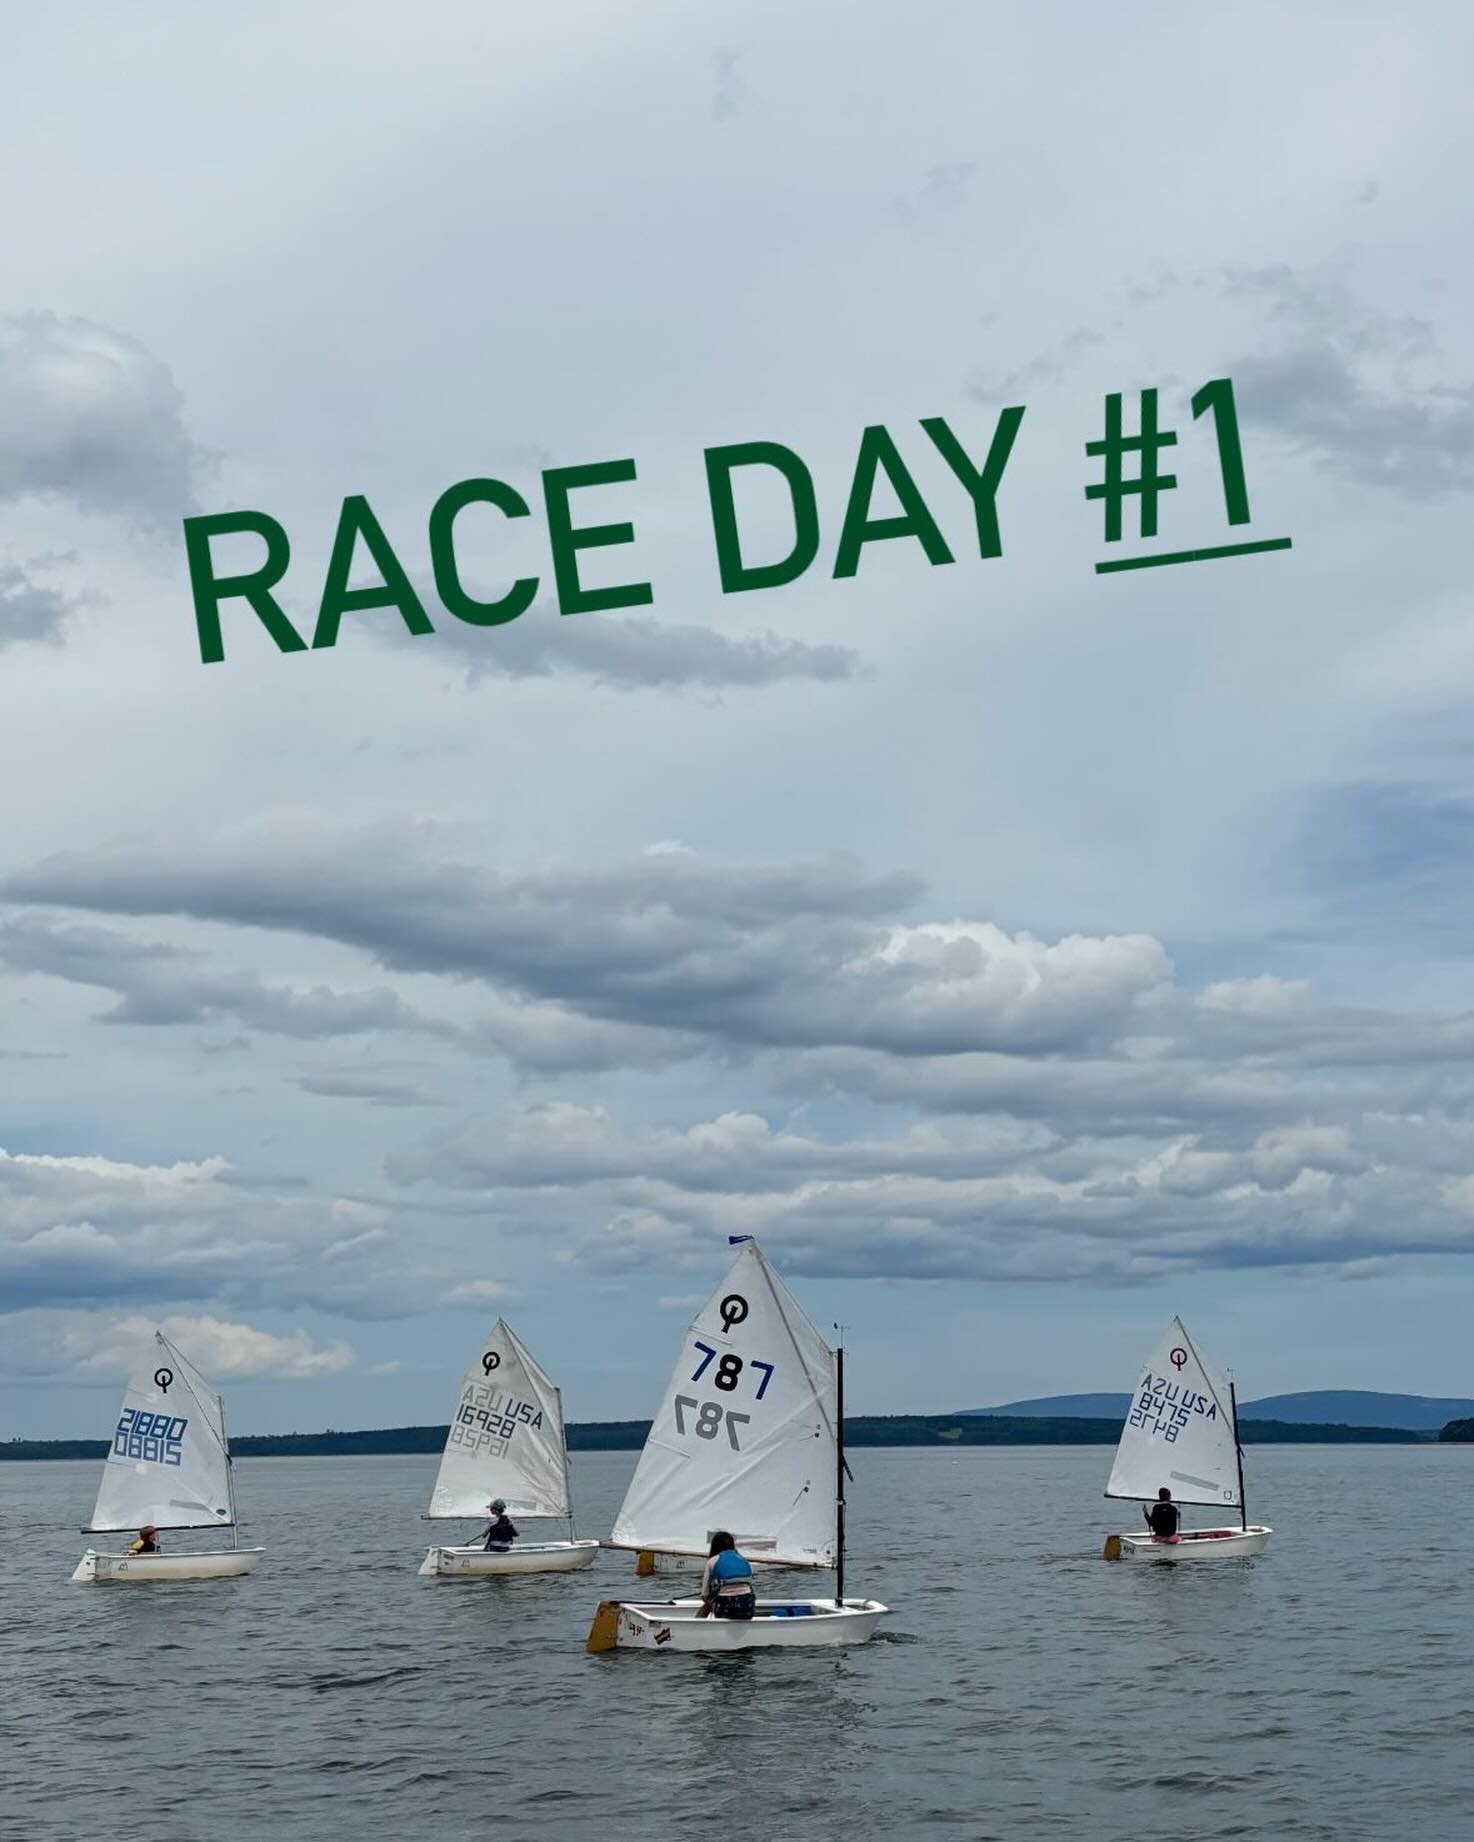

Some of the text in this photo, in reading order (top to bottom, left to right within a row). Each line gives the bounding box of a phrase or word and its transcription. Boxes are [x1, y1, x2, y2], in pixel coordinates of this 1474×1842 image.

[691, 1341, 774, 1400] 787
[456, 1404, 516, 1439] 16928
[505, 1398, 543, 1430] USA
[1139, 1392, 1191, 1427] 8475
[1181, 1389, 1216, 1421] USA
[117, 1408, 188, 1441] 21880
